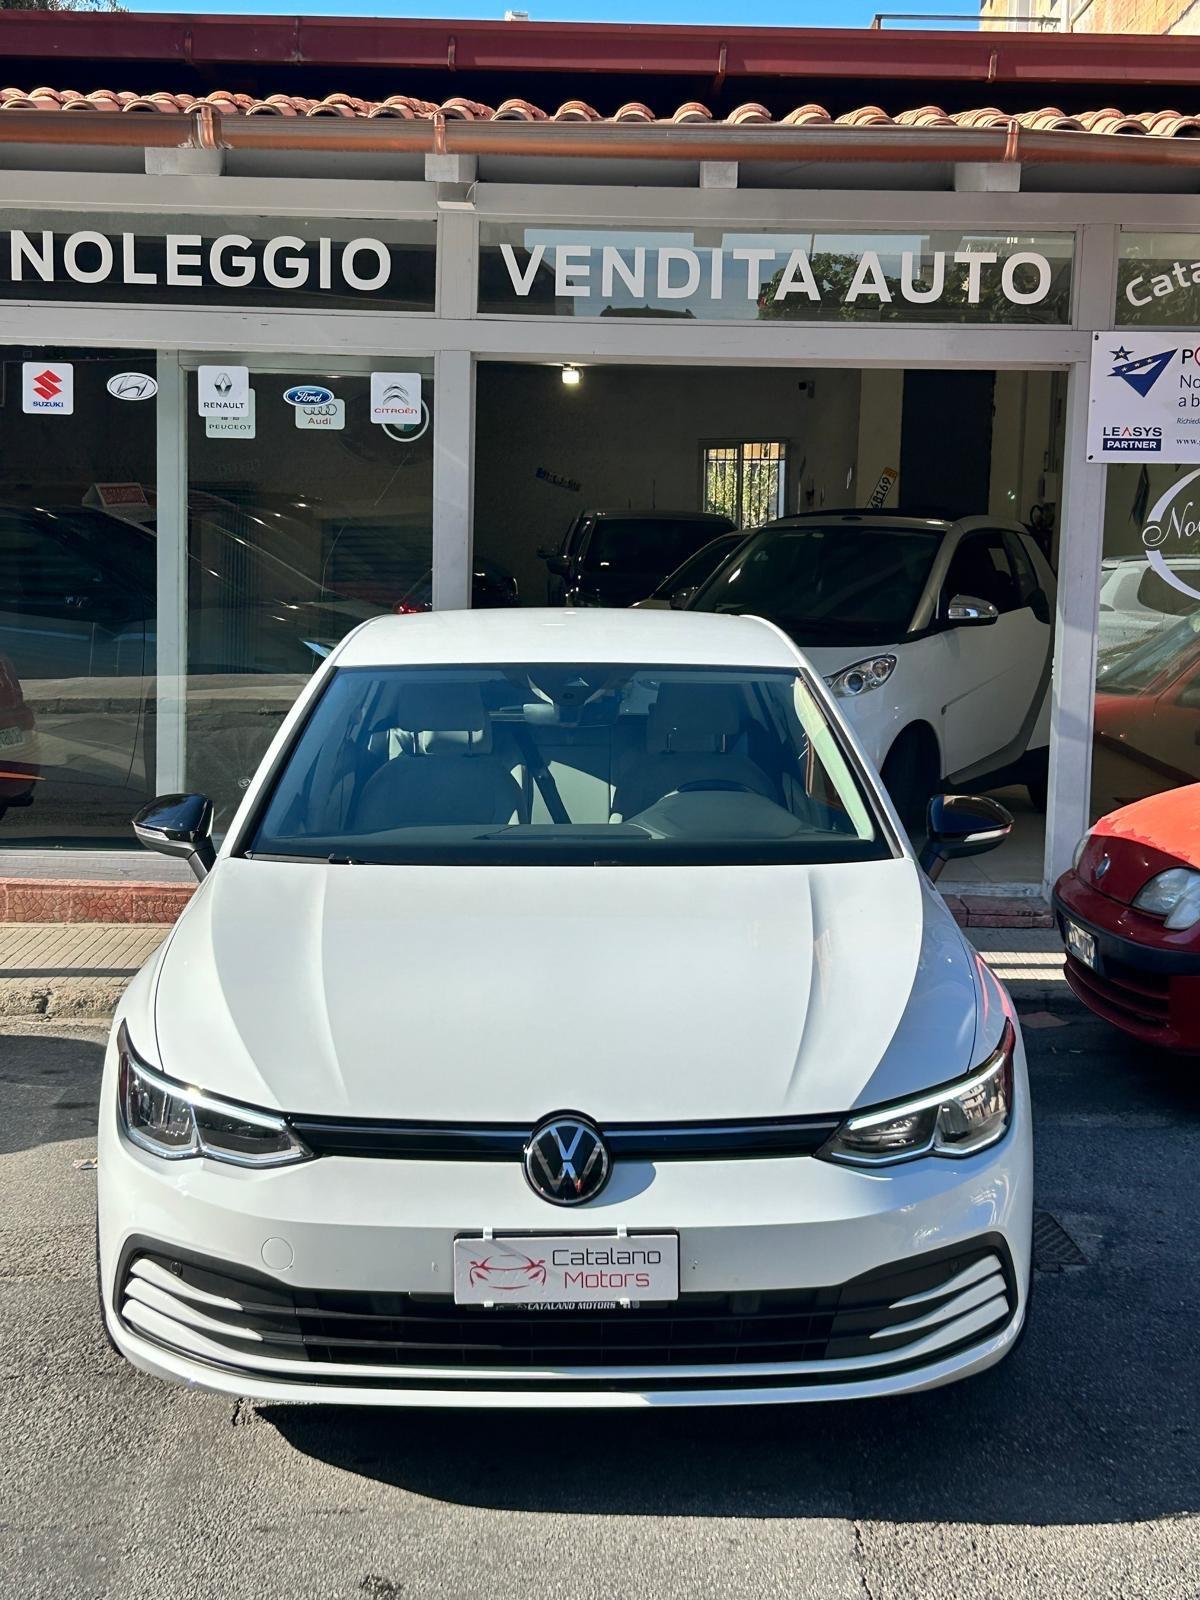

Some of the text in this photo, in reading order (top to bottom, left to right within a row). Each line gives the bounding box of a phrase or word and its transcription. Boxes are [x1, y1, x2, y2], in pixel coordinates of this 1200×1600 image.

[9, 229, 392, 291] NOLEGGIO
[500, 243, 1053, 305] VENDITA AUTO
[294, 390, 323, 403] Ford
[1178, 396, 1187, 407] a
[203, 401, 245, 409] RENAULT
[307, 417, 332, 425] Audi
[1103, 426, 1163, 437] LEASYS
[1106, 440, 1157, 449] PARTNER
[552, 1247, 662, 1266] Catalano
[564, 1269, 650, 1289] Motors
